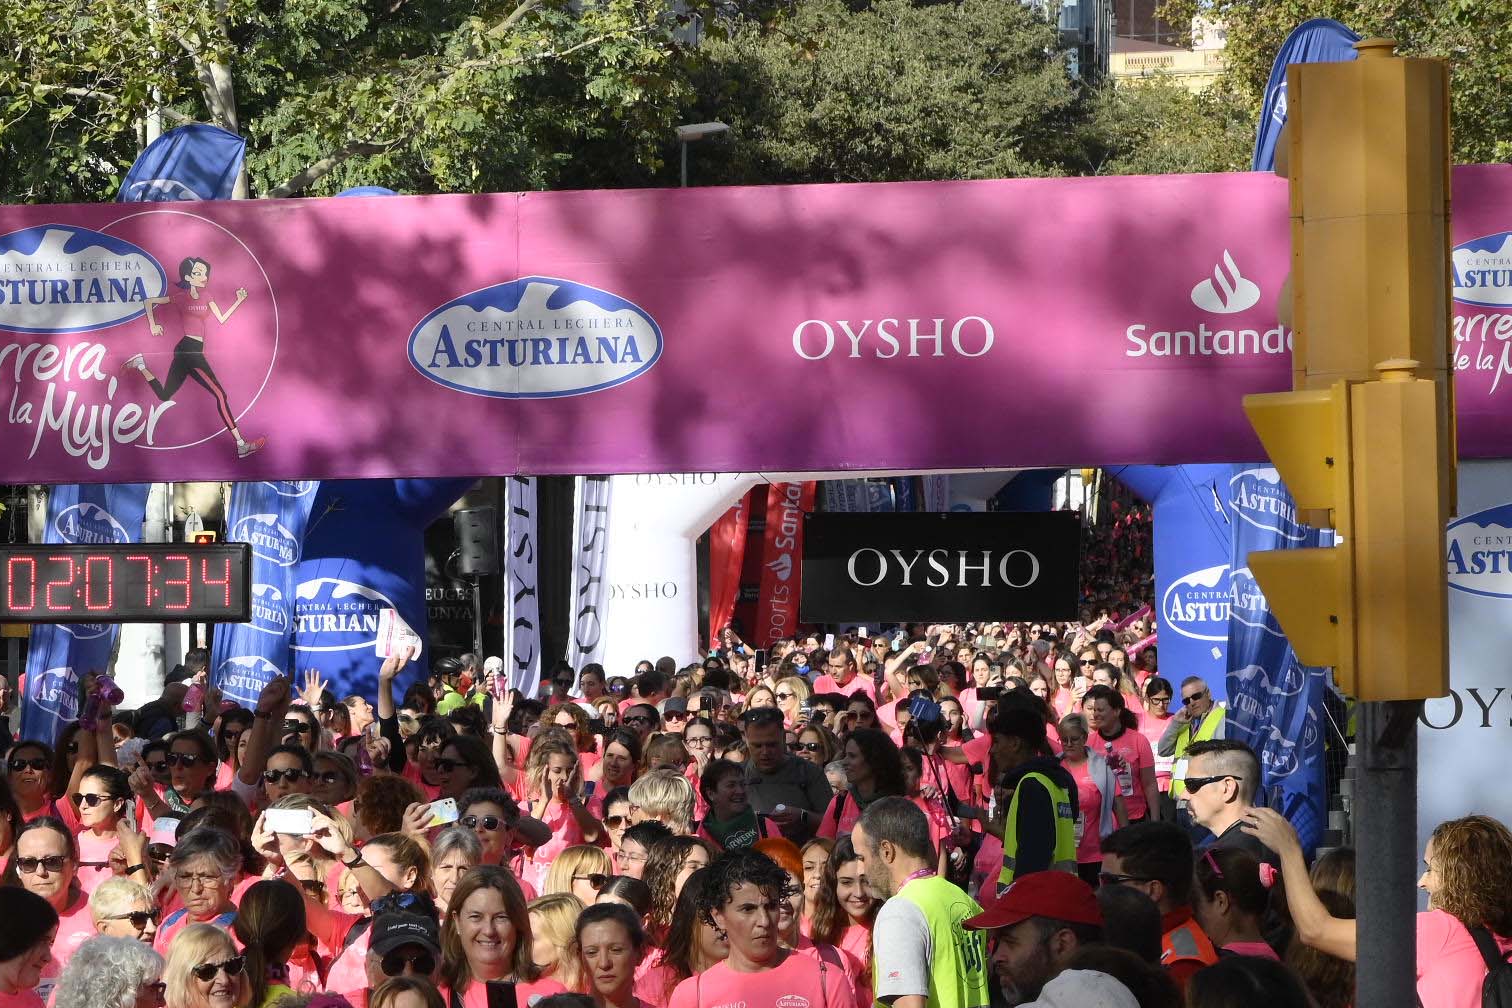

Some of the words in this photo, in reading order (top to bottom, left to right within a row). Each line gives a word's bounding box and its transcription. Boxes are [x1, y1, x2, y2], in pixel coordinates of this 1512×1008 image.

[69, 260, 142, 272] LECHERA
[1466, 257, 1511, 266] CENTRA
[466, 319, 545, 332] CENTRAL
[553, 317, 634, 330] LECHERA
[792, 315, 995, 360] OYSHO
[1126, 323, 1293, 357] Santand
[1453, 313, 1512, 342] arre
[427, 324, 643, 368] ASTURIANA
[1475, 343, 1494, 370] la
[8, 386, 33, 425] la
[28, 374, 177, 470] Mujer
[1236, 482, 1296, 524] ASTURIA
[8, 555, 230, 610] 02:07:34
[513, 475, 535, 669] OYSH
[576, 475, 608, 654] OYSH
[848, 547, 1040, 588] OYSHO
[296, 603, 332, 612] ENTRAL
[769, 584, 789, 641] ports
[1186, 591, 1228, 600] CENTRA
[292, 613, 379, 633] STURIAN
